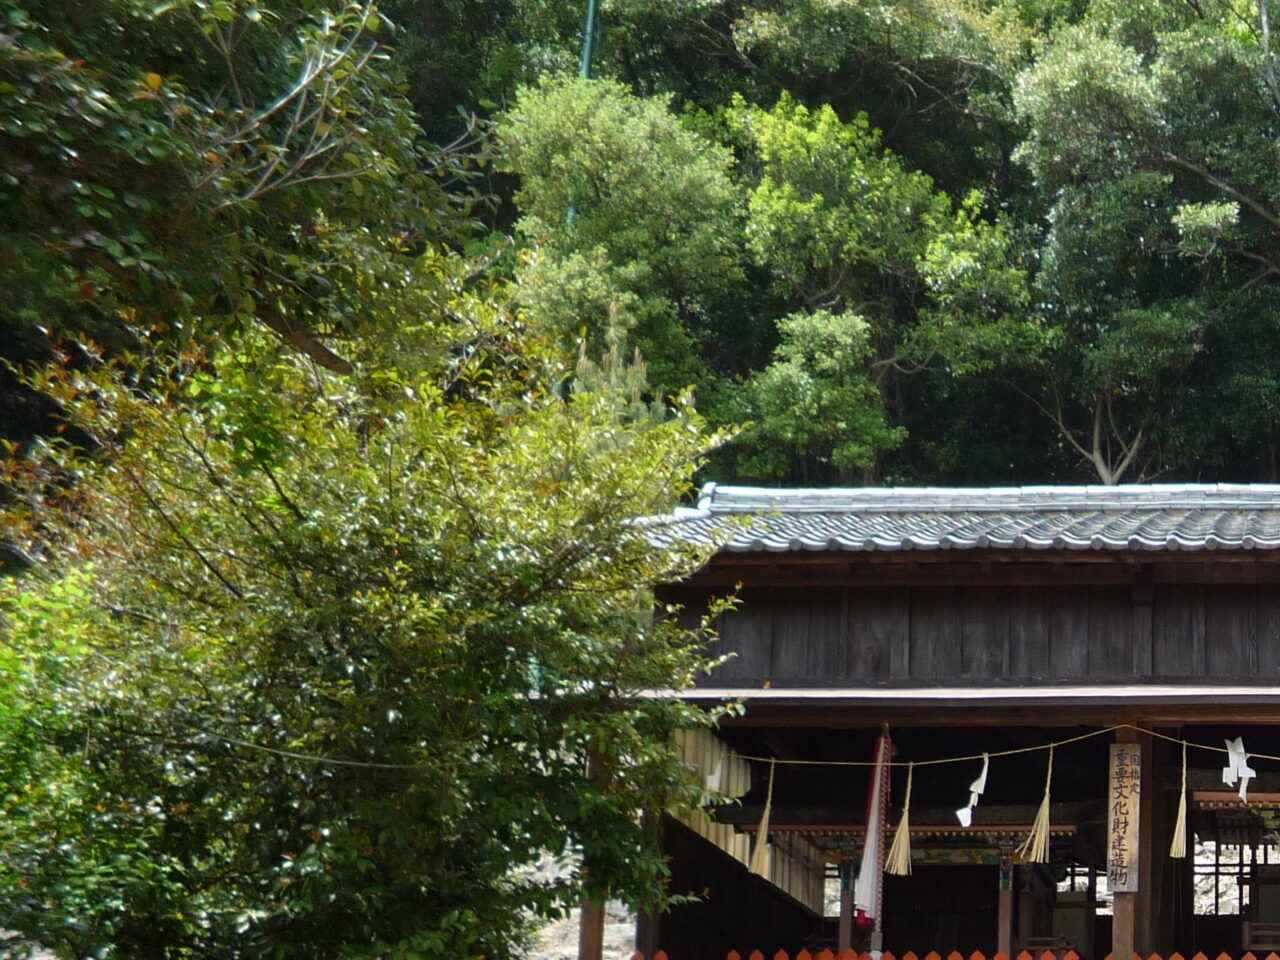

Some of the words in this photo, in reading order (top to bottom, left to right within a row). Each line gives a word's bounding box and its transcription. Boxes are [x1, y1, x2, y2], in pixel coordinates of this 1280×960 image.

[1109, 748, 1131, 887] 重要文化財建造物
